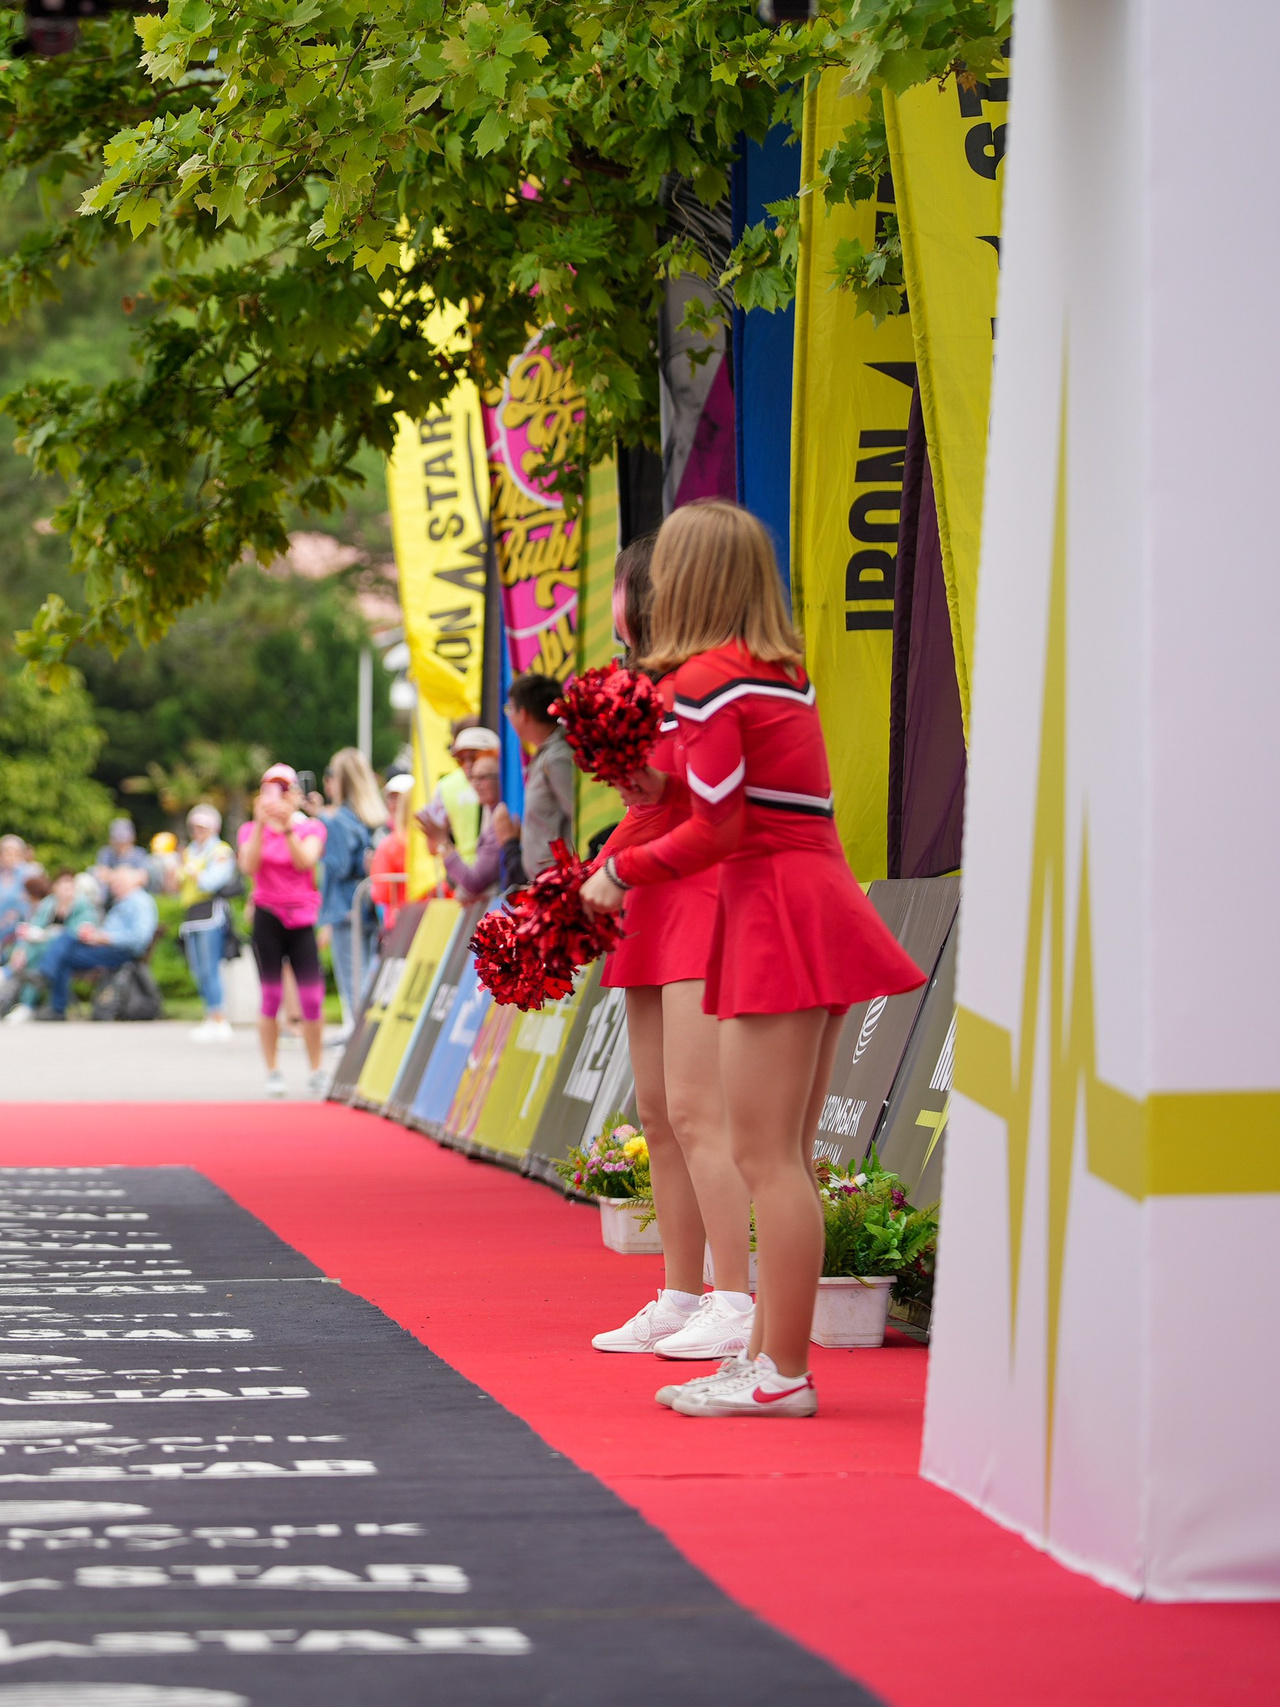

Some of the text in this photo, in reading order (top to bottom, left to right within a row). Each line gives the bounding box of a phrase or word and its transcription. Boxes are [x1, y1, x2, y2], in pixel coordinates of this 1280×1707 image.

[423, 413, 465, 543] STAR
[845, 429, 908, 631] IRON
[7, 1327, 257, 1341] STAR
[26, 1385, 311, 1400] STAR
[49, 1459, 378, 1477] STAR
[74, 1563, 470, 1591] STAR
[91, 1626, 532, 1654] STAR
